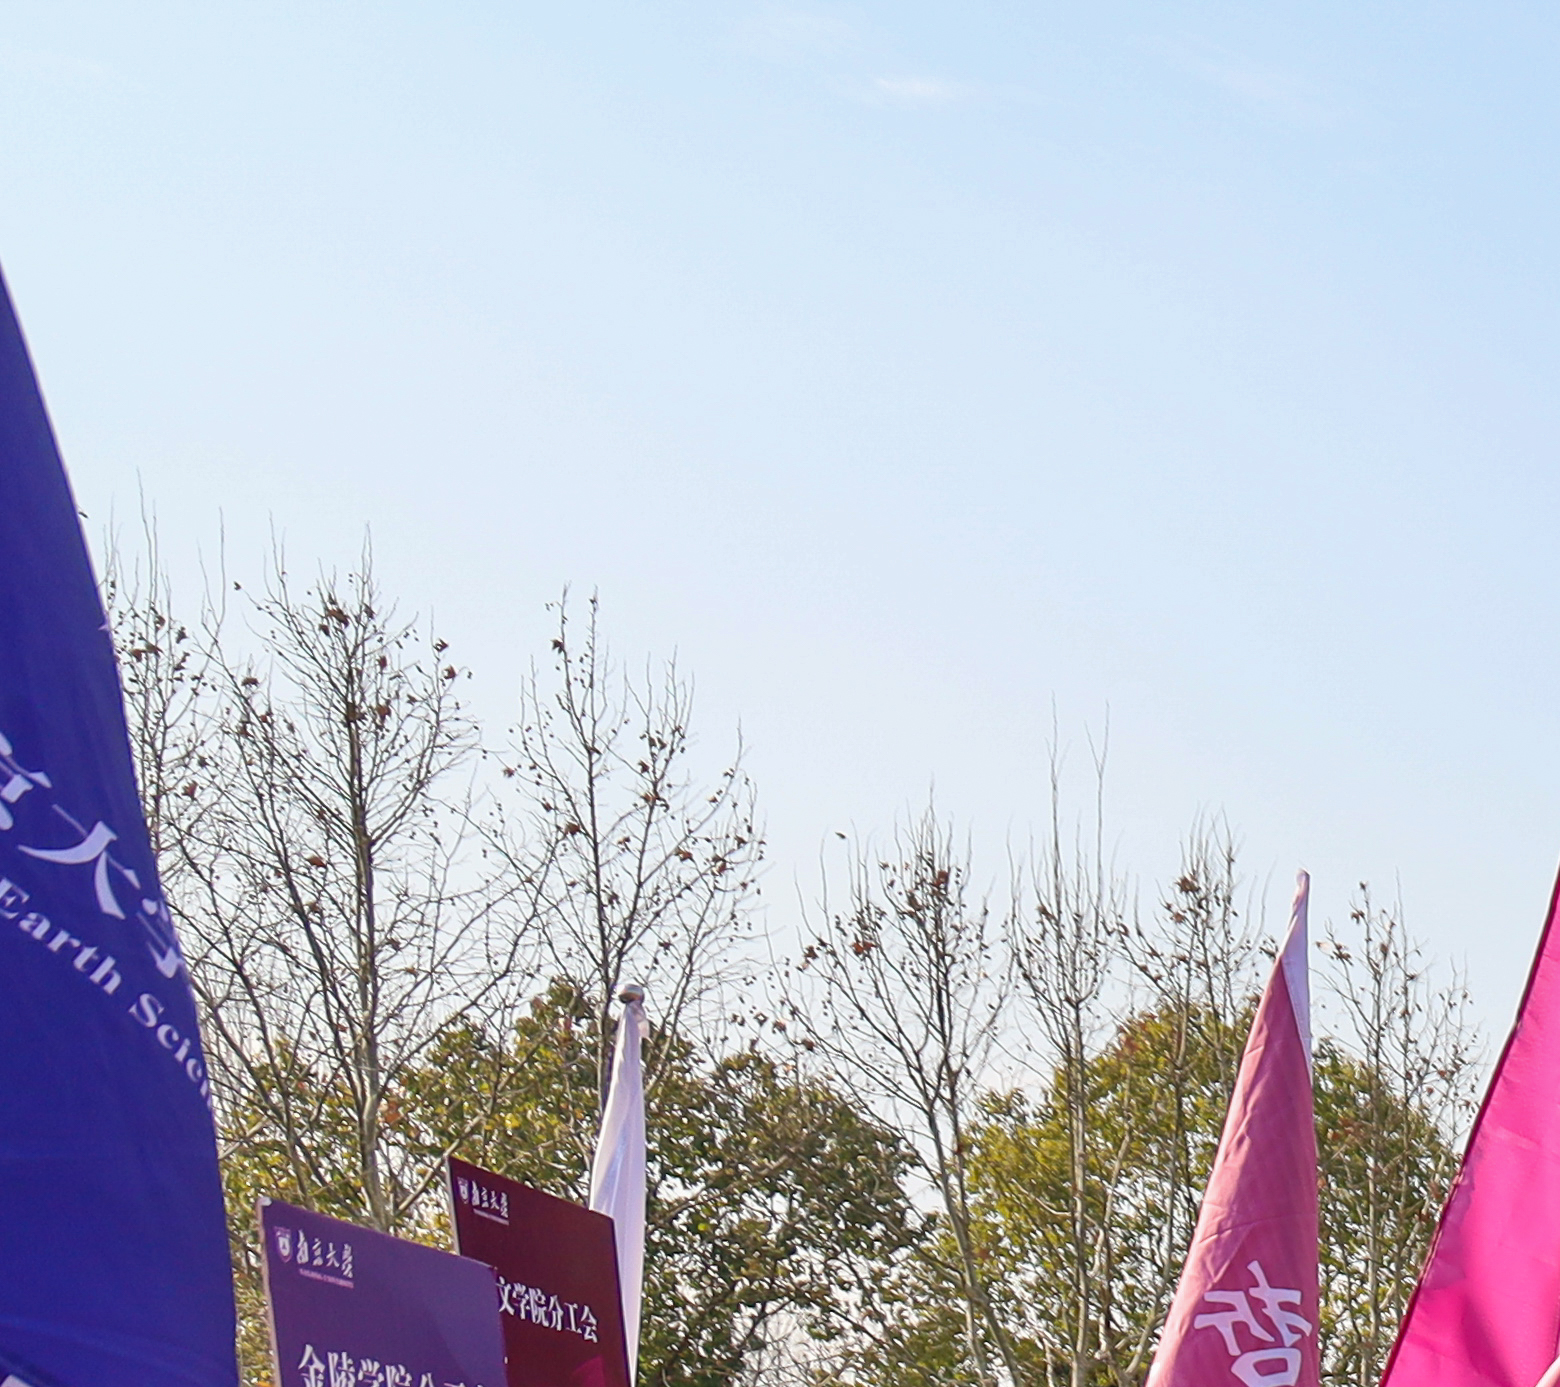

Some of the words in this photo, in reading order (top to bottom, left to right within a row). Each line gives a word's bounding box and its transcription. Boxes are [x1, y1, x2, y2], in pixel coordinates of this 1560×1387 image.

[0, 877, 123, 996] Earth
[496, 1276, 598, 1343] 文学院分工会
